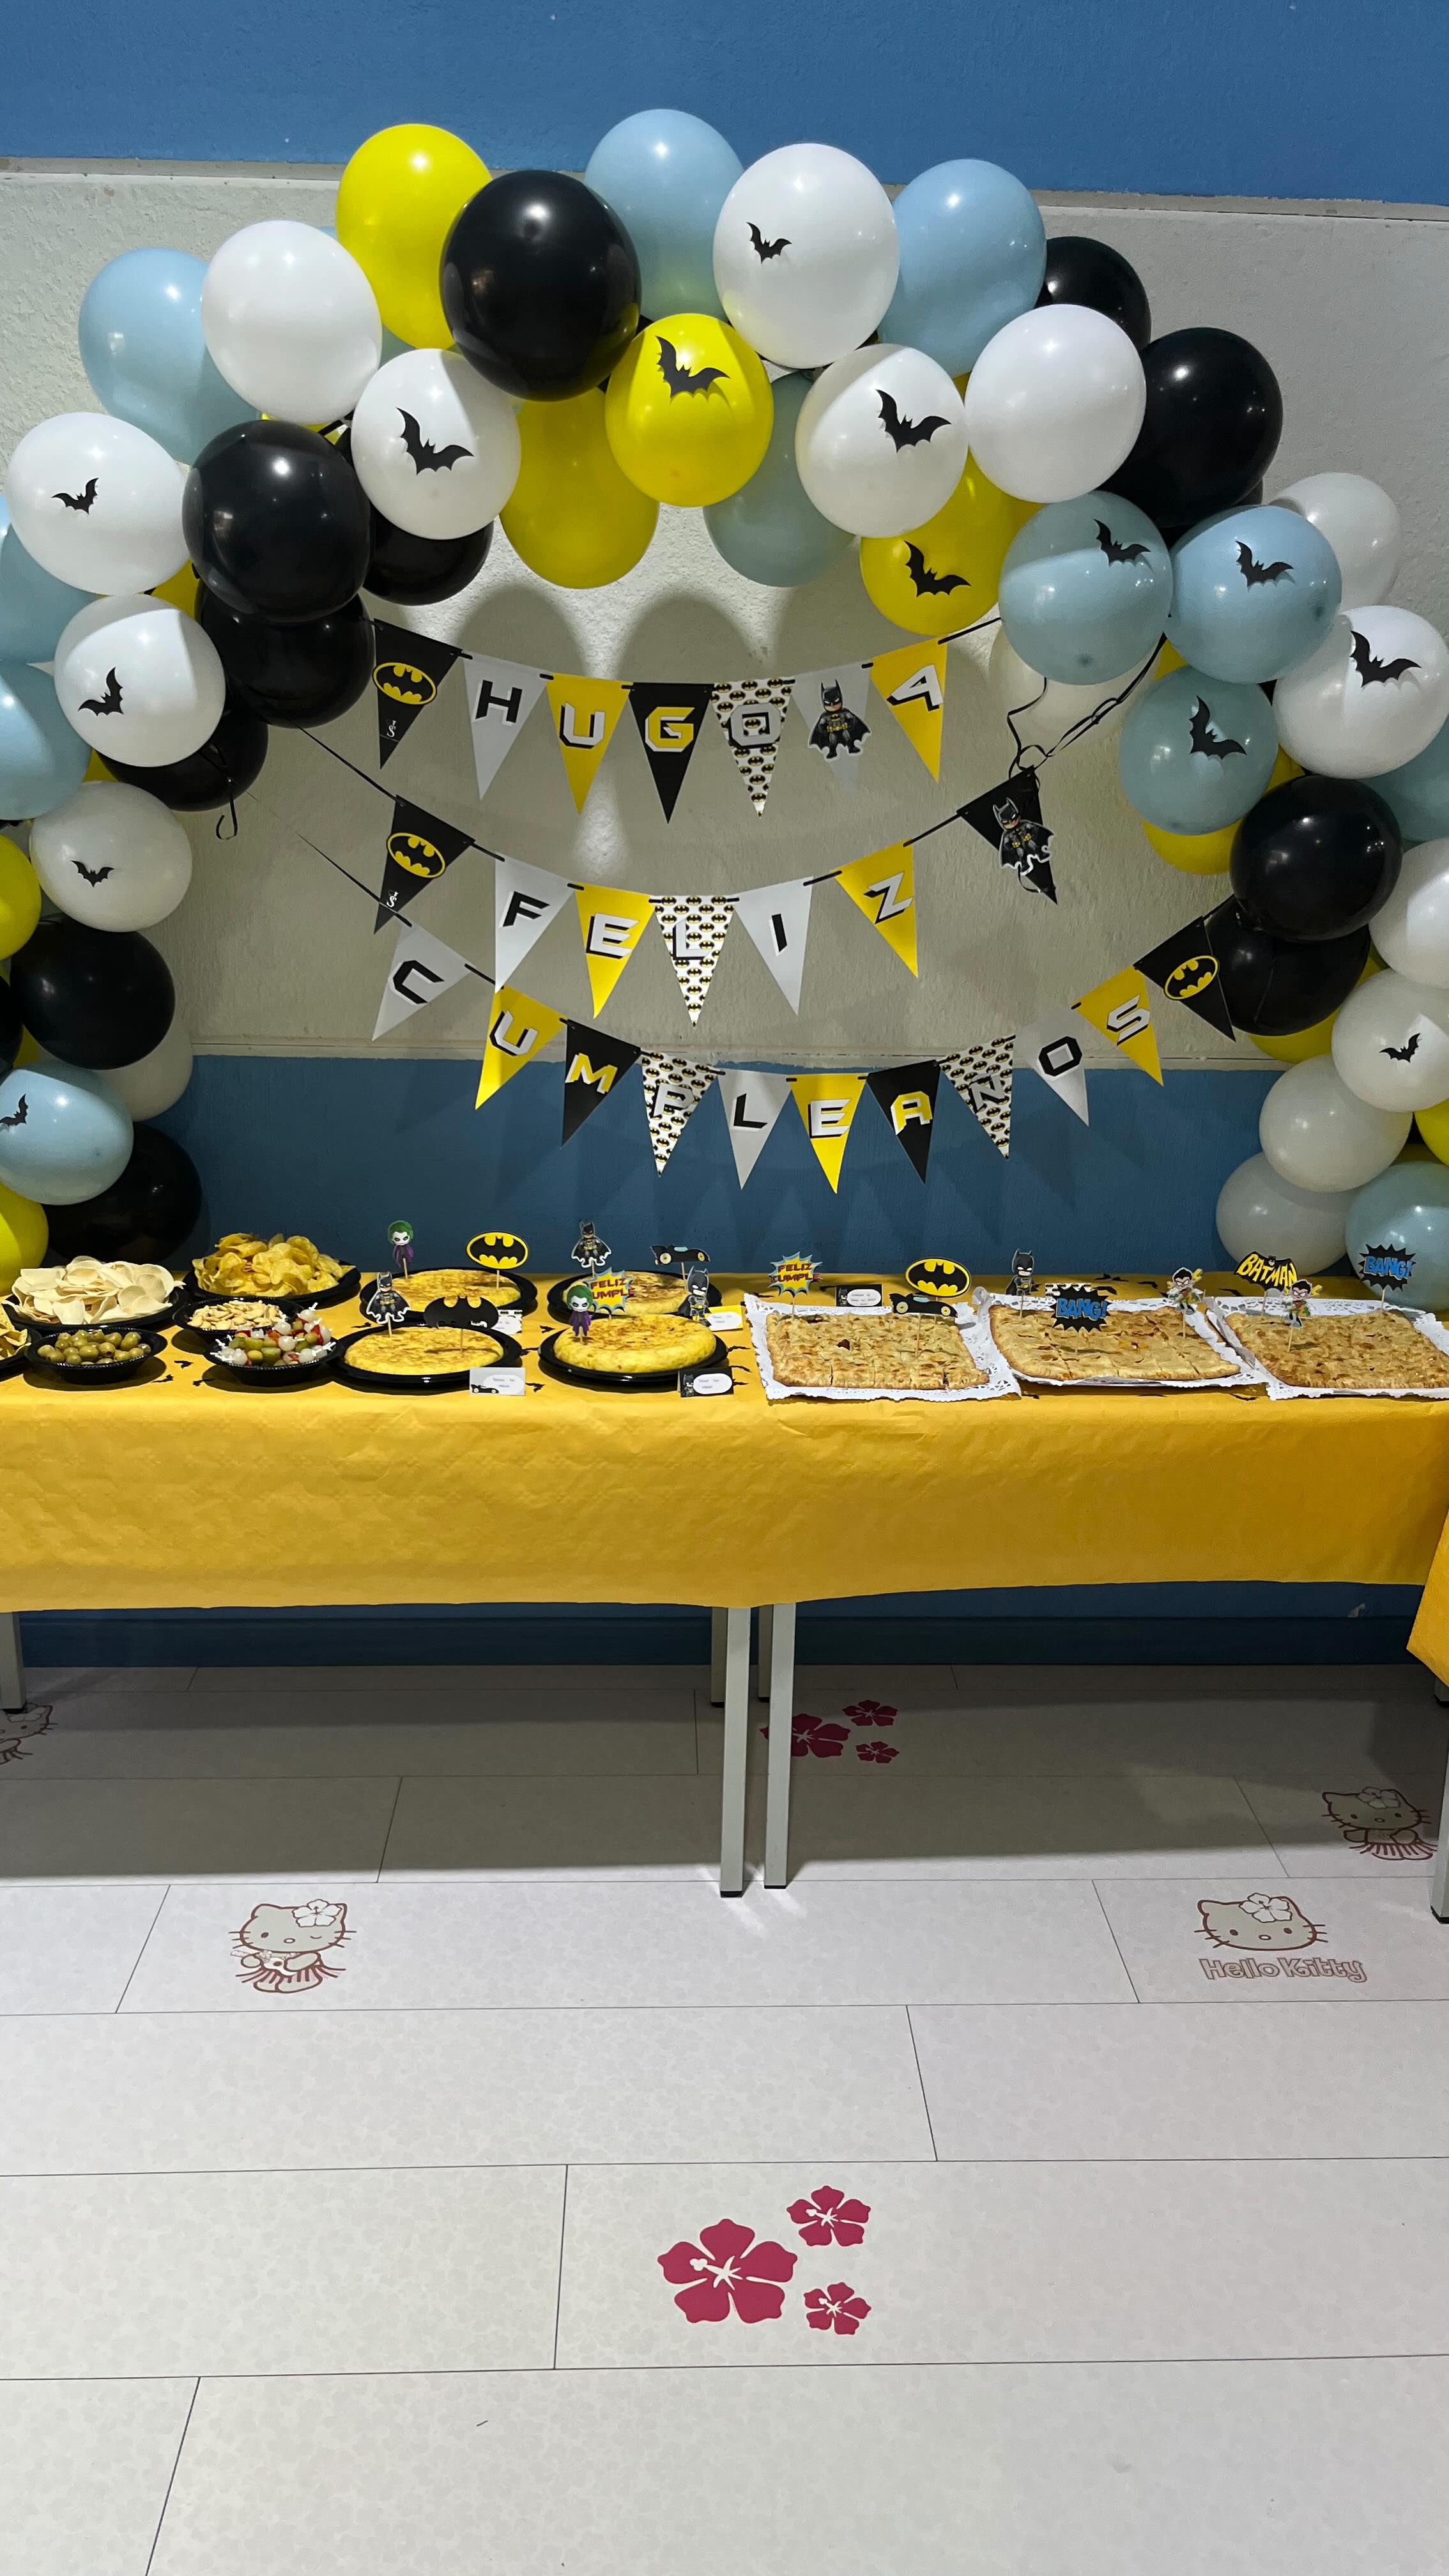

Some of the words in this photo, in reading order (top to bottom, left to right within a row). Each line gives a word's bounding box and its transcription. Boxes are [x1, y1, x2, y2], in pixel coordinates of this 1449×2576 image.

[471, 679, 783, 753] HUGO
[886, 664, 944, 712] 4
[500, 871, 913, 960] FELIZ
[778, 1263, 813, 1273] FELIZ
[1236, 1254, 1298, 1288] BATMAN
[1363, 1256, 1413, 1281] BANG!
[591, 1278, 627, 1290] FELIZ
[592, 1287, 636, 1300] UMPLE
[1056, 1298, 1107, 1321] BANG!
[1199, 1957, 1280, 1980] Hello
[1276, 1956, 1368, 1983] Kitty
